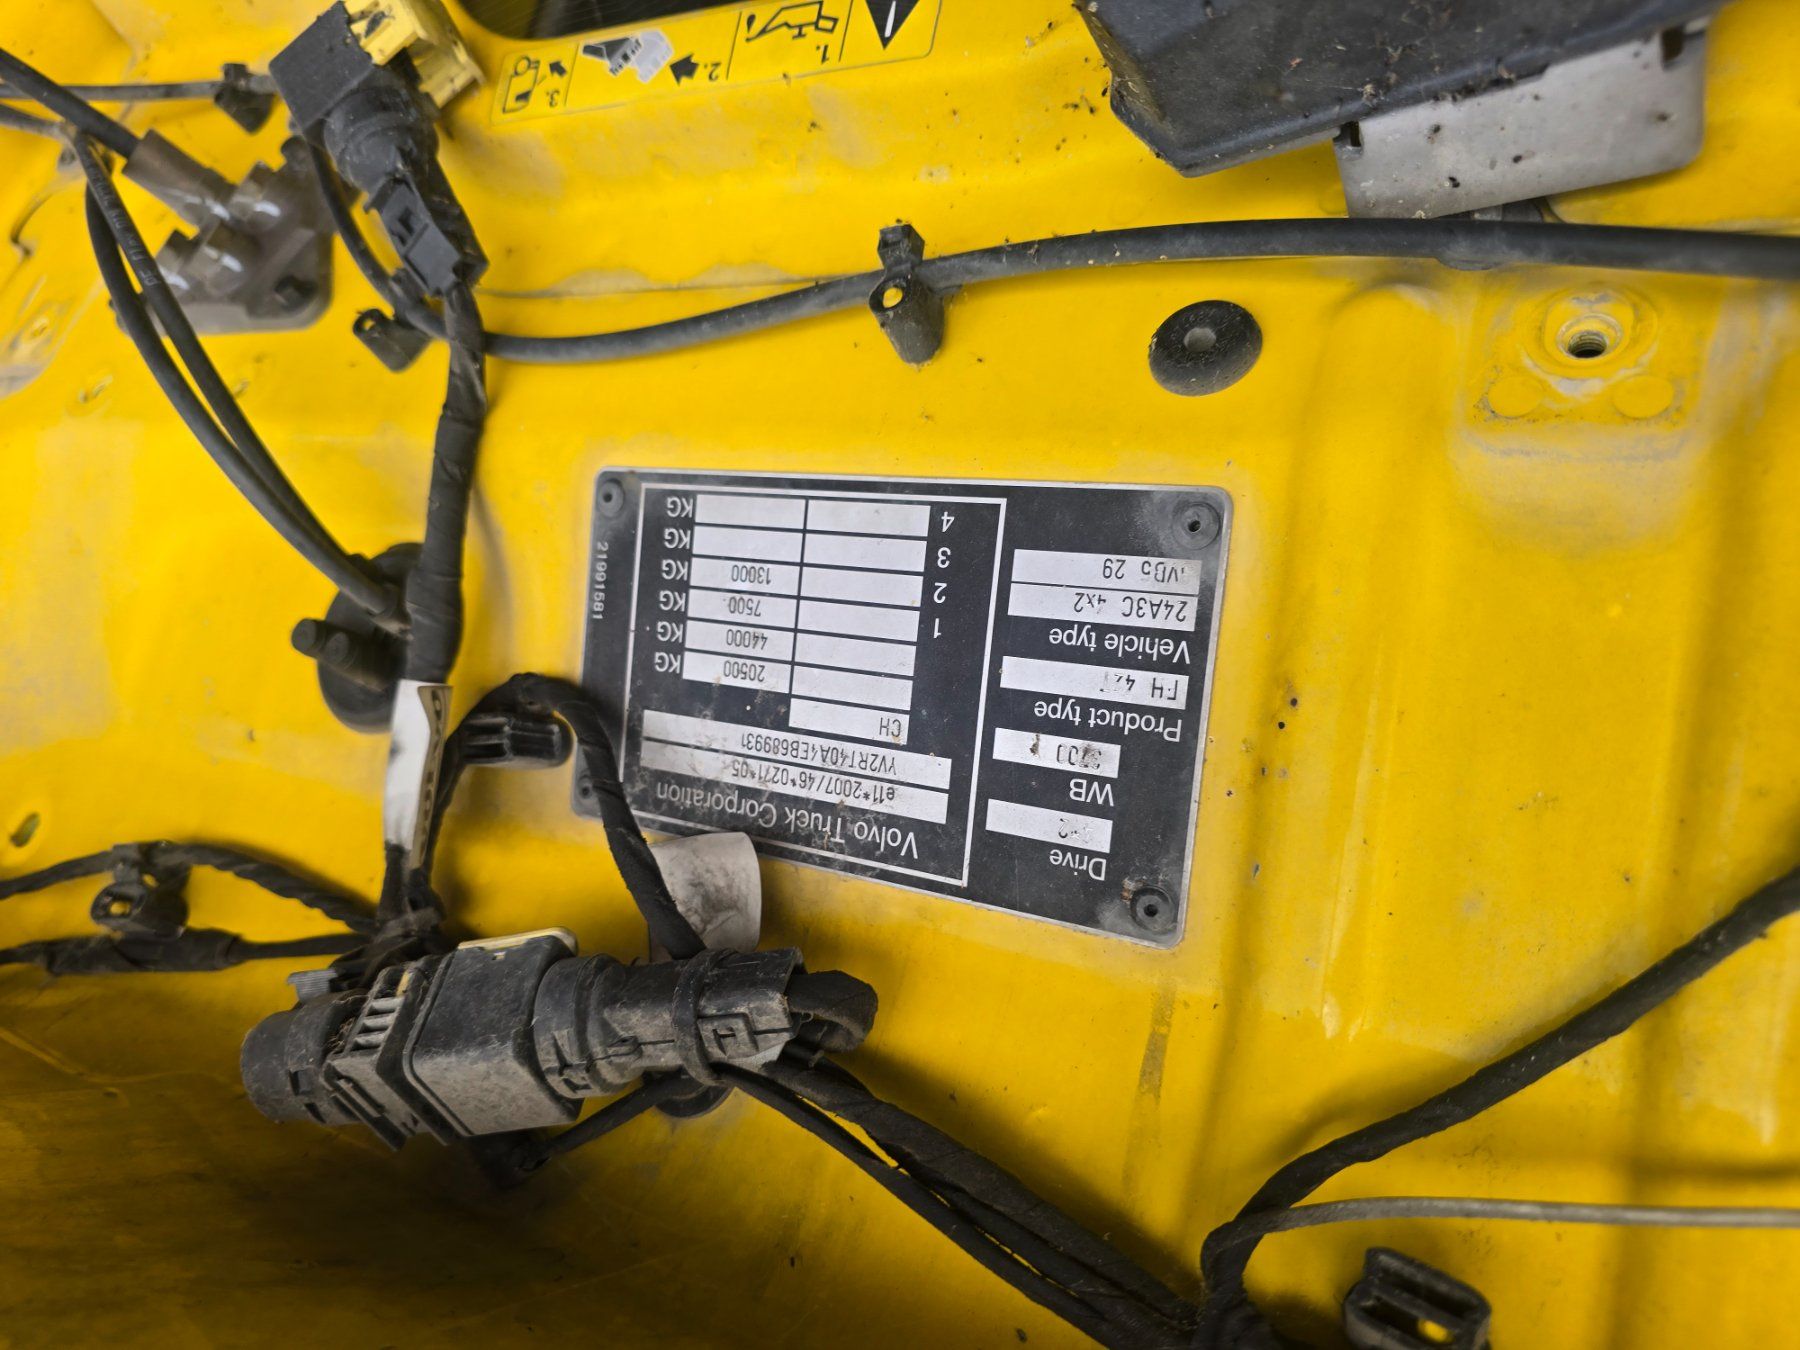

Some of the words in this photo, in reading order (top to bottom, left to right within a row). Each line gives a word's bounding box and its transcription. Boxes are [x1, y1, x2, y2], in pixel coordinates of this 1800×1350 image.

[666, 496, 694, 518] KG
[940, 511, 955, 533] 4
[663, 527, 691, 549] KG
[936, 546, 951, 569] 3
[1102, 558, 1127, 580] 29
[591, 542, 608, 621] 21991581
[660, 559, 689, 581] KG
[731, 564, 772, 586] 13000
[658, 590, 686, 612] KG
[933, 582, 948, 604] 2
[1073, 592, 1107, 614] 4x2
[728, 596, 762, 617] 7500
[1121, 596, 1188, 623] 24A3C
[656, 621, 684, 643] KG
[726, 628, 768, 651] 44000
[933, 618, 942, 639] 1
[1048, 623, 1097, 652] type
[1103, 632, 1191, 665] Vehicle
[653, 651, 682, 674] KG
[723, 659, 766, 683] 20500
[1033, 697, 1082, 725] type
[879, 716, 903, 737] CH
[1087, 707, 1183, 743] Product
[1068, 777, 1115, 807] WB
[656, 781, 778, 830] Corporation
[784, 806, 846, 844] Truck
[853, 821, 919, 859] Volvo
[1049, 849, 1107, 881] Drive
